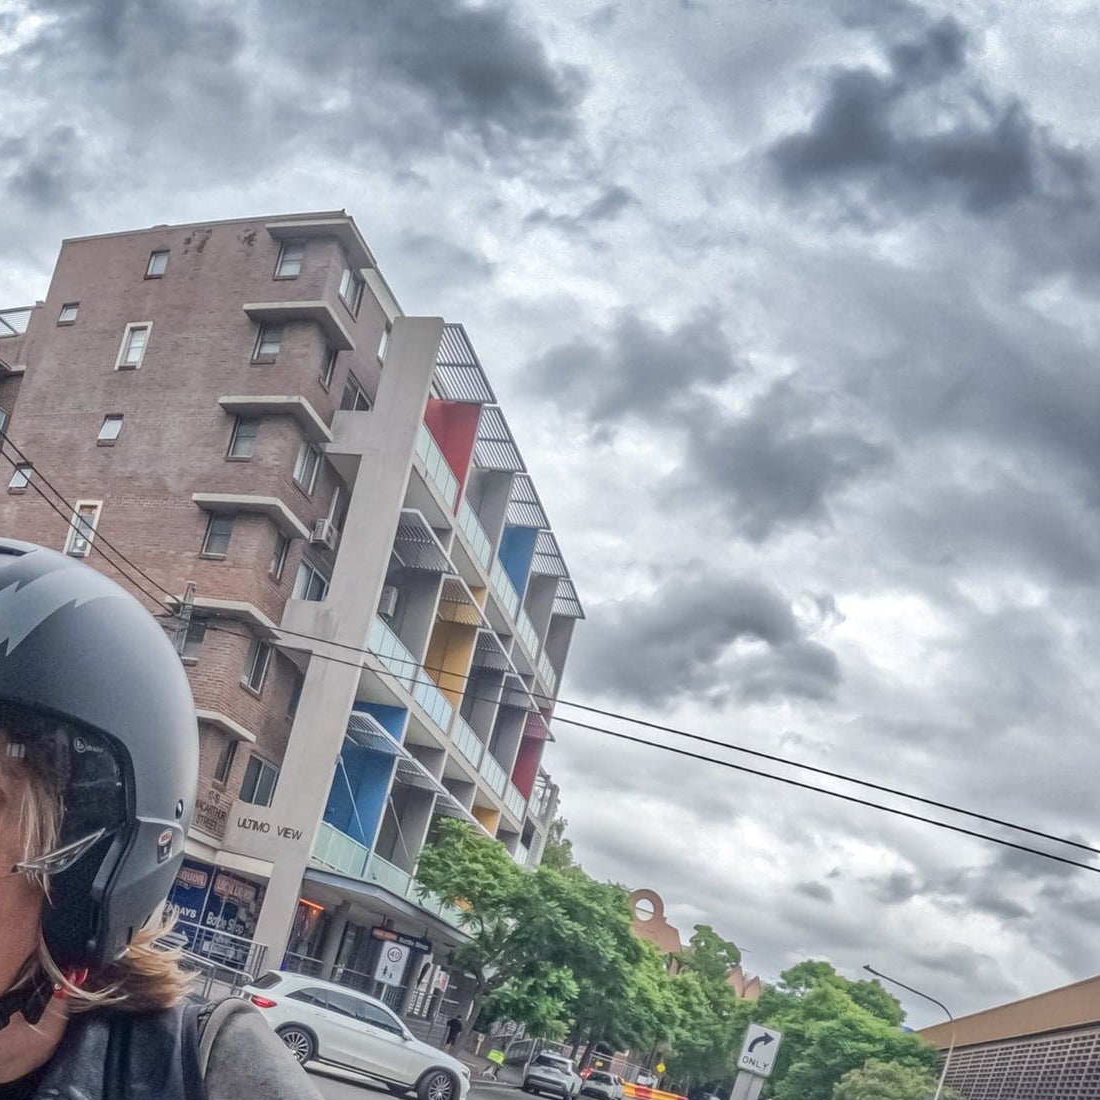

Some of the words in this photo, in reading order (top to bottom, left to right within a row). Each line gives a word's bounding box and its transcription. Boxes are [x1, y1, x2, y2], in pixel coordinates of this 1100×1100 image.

[237, 817, 271, 833] ULTIMO
[277, 825, 303, 840] VIEW
[742, 1055, 769, 1070] ONLY
